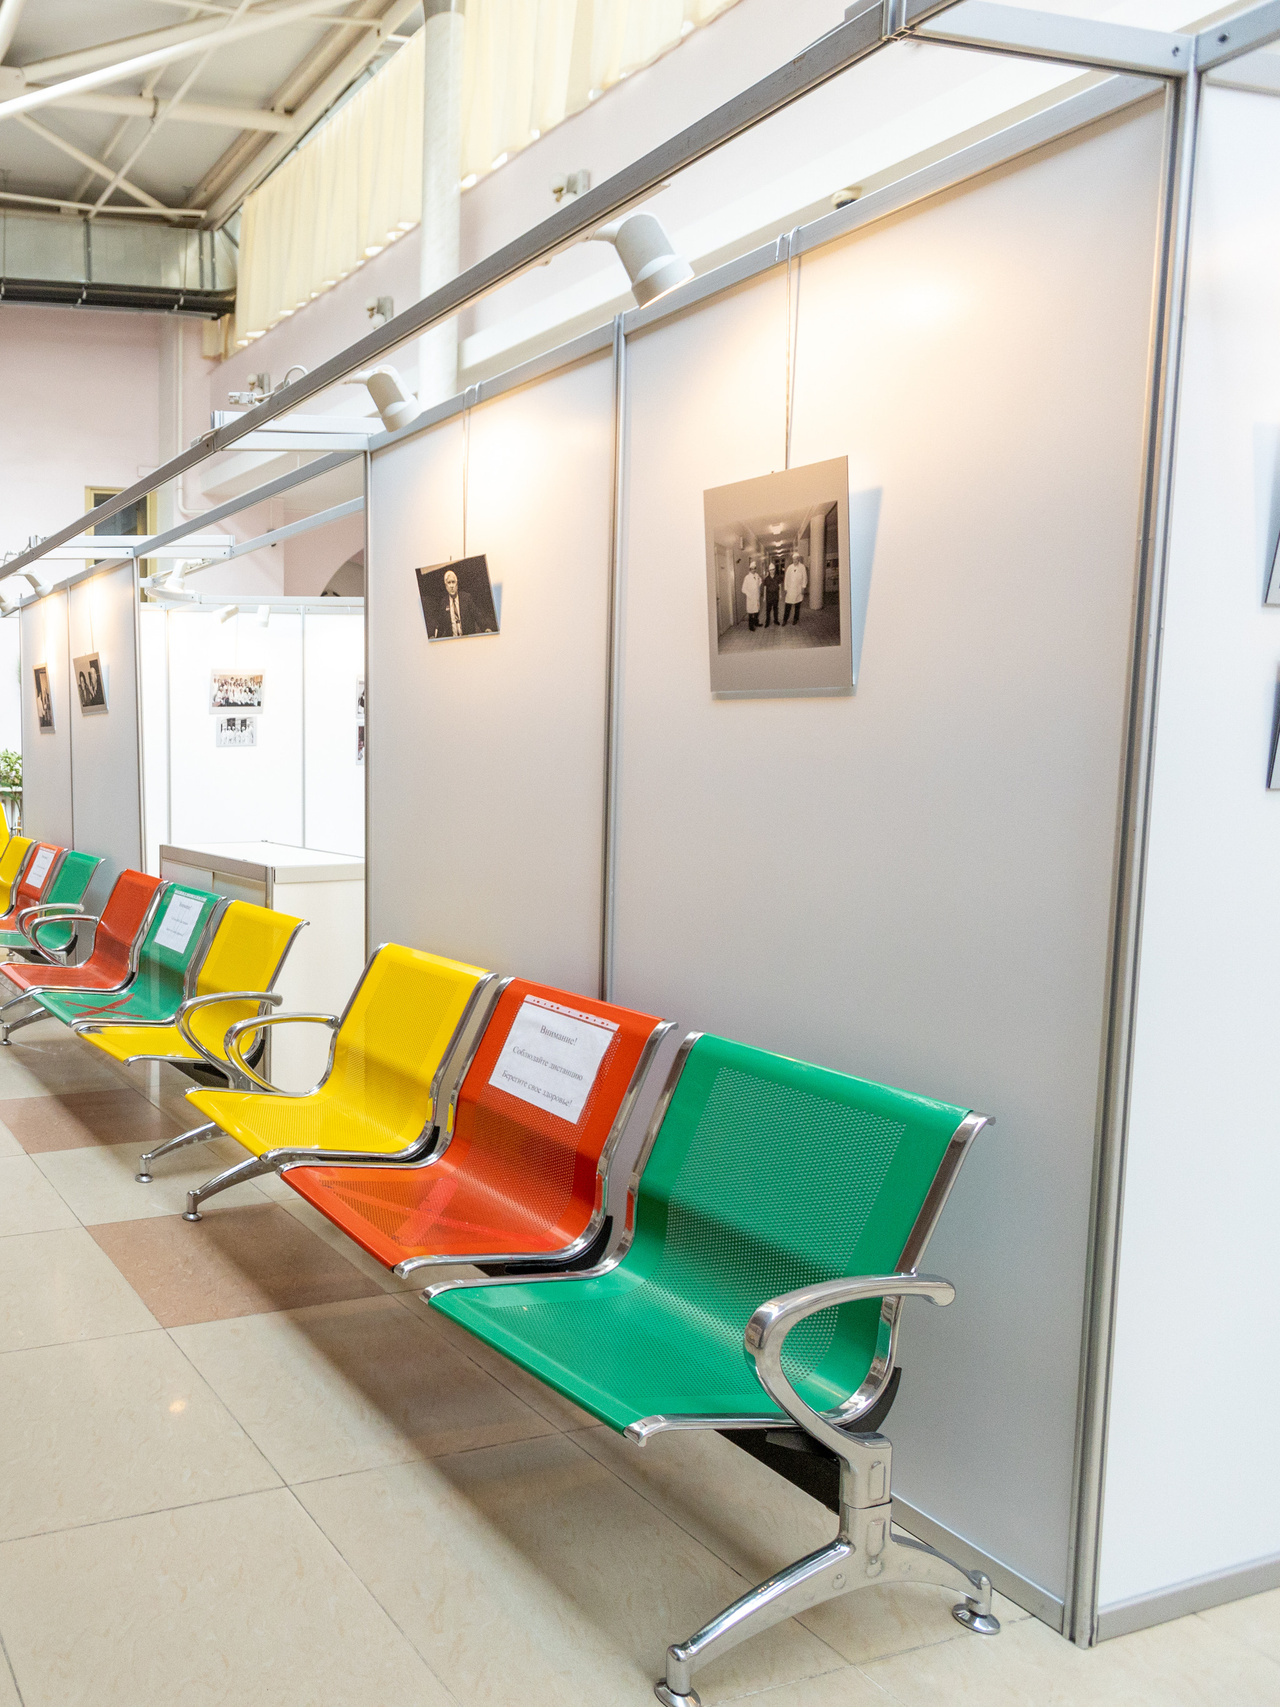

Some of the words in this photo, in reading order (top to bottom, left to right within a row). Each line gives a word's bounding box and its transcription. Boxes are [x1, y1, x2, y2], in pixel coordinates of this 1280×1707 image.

[539, 1024, 578, 1047] Внимание!
[512, 1045, 549, 1067] Соблюдайте
[549, 1062, 584, 1081] дистанцию
[501, 1069, 528, 1088] Берегите
[542, 1089, 573, 1108] здоровье!
